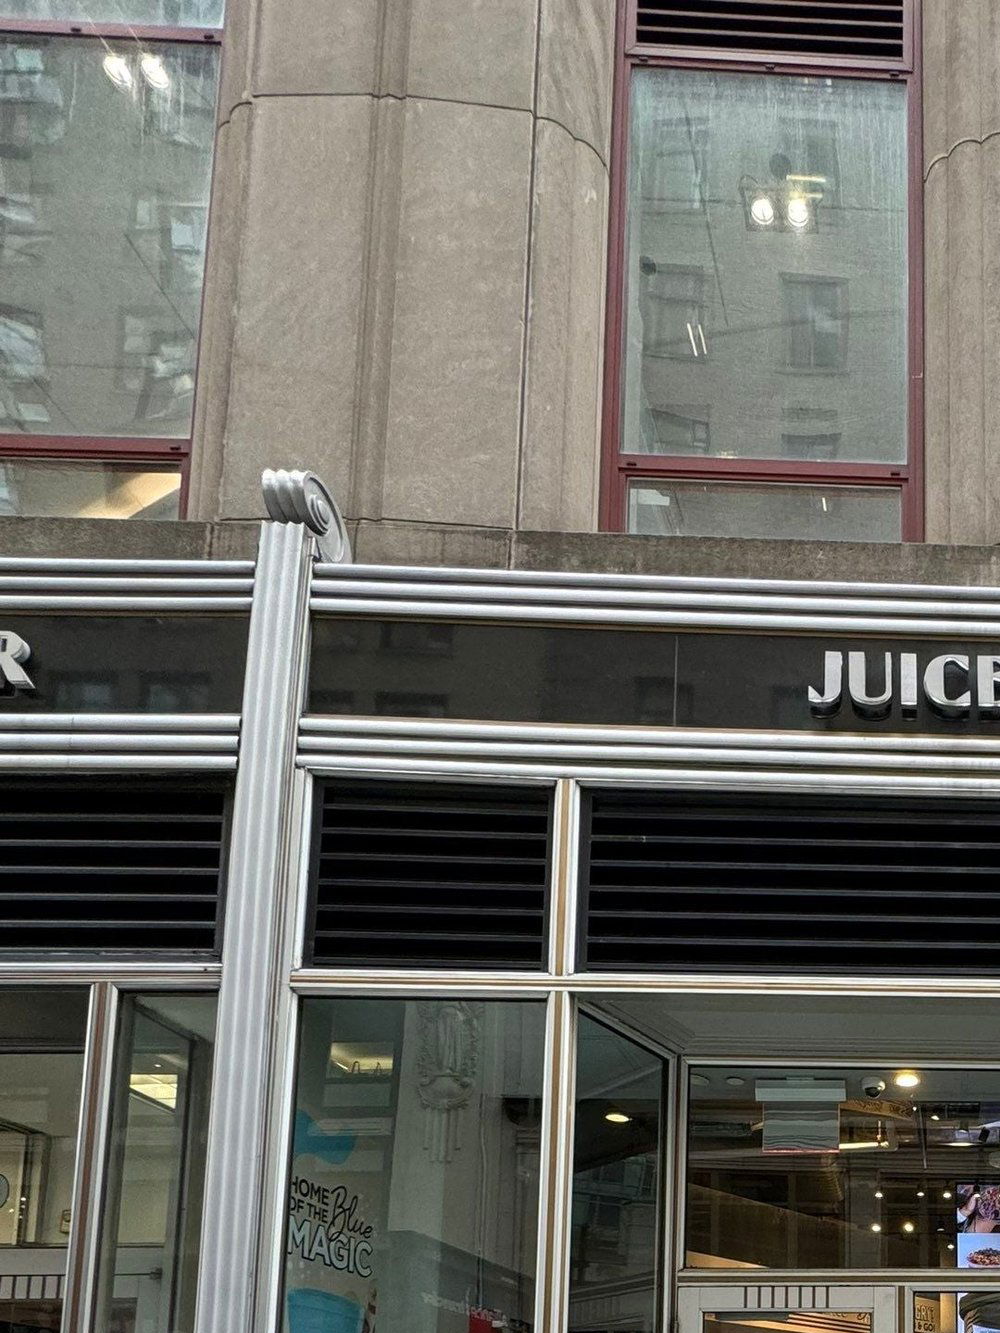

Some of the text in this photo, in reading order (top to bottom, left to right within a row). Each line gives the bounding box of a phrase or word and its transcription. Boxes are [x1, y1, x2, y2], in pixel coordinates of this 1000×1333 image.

[291, 1176, 330, 1207] HOME
[307, 1202, 328, 1224] THE
[327, 1185, 374, 1242] Blue
[288, 1213, 374, 1277] MAGIC
